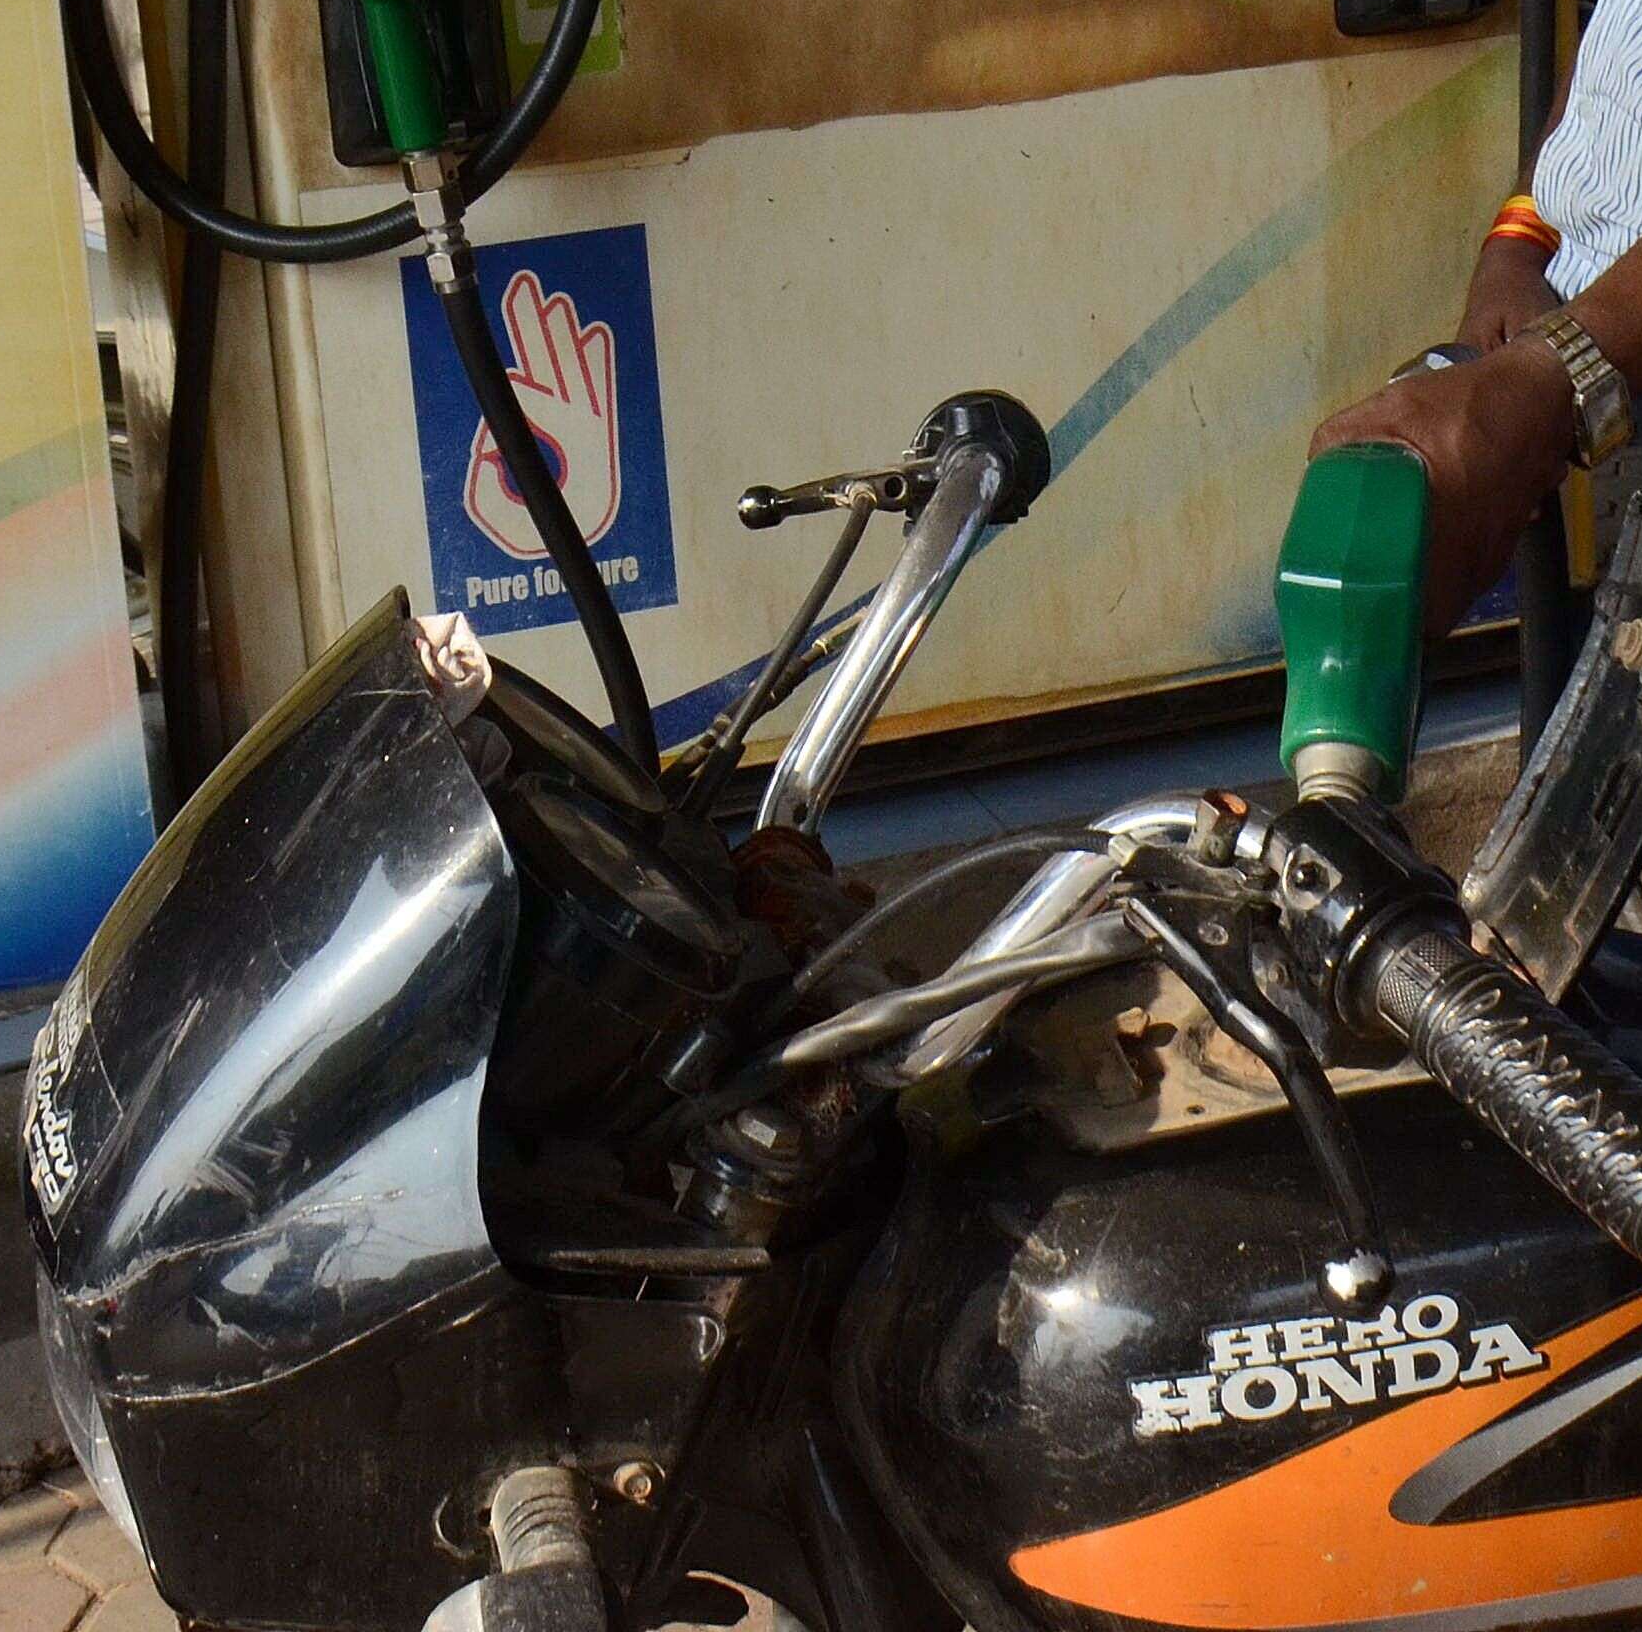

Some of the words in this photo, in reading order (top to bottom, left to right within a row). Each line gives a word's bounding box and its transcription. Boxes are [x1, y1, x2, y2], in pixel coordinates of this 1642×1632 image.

[466, 572, 530, 609] Pure
[534, 565, 567, 597] fo
[1209, 1294, 1460, 1371] HERO
[1131, 1324, 1545, 1440] HONDA
